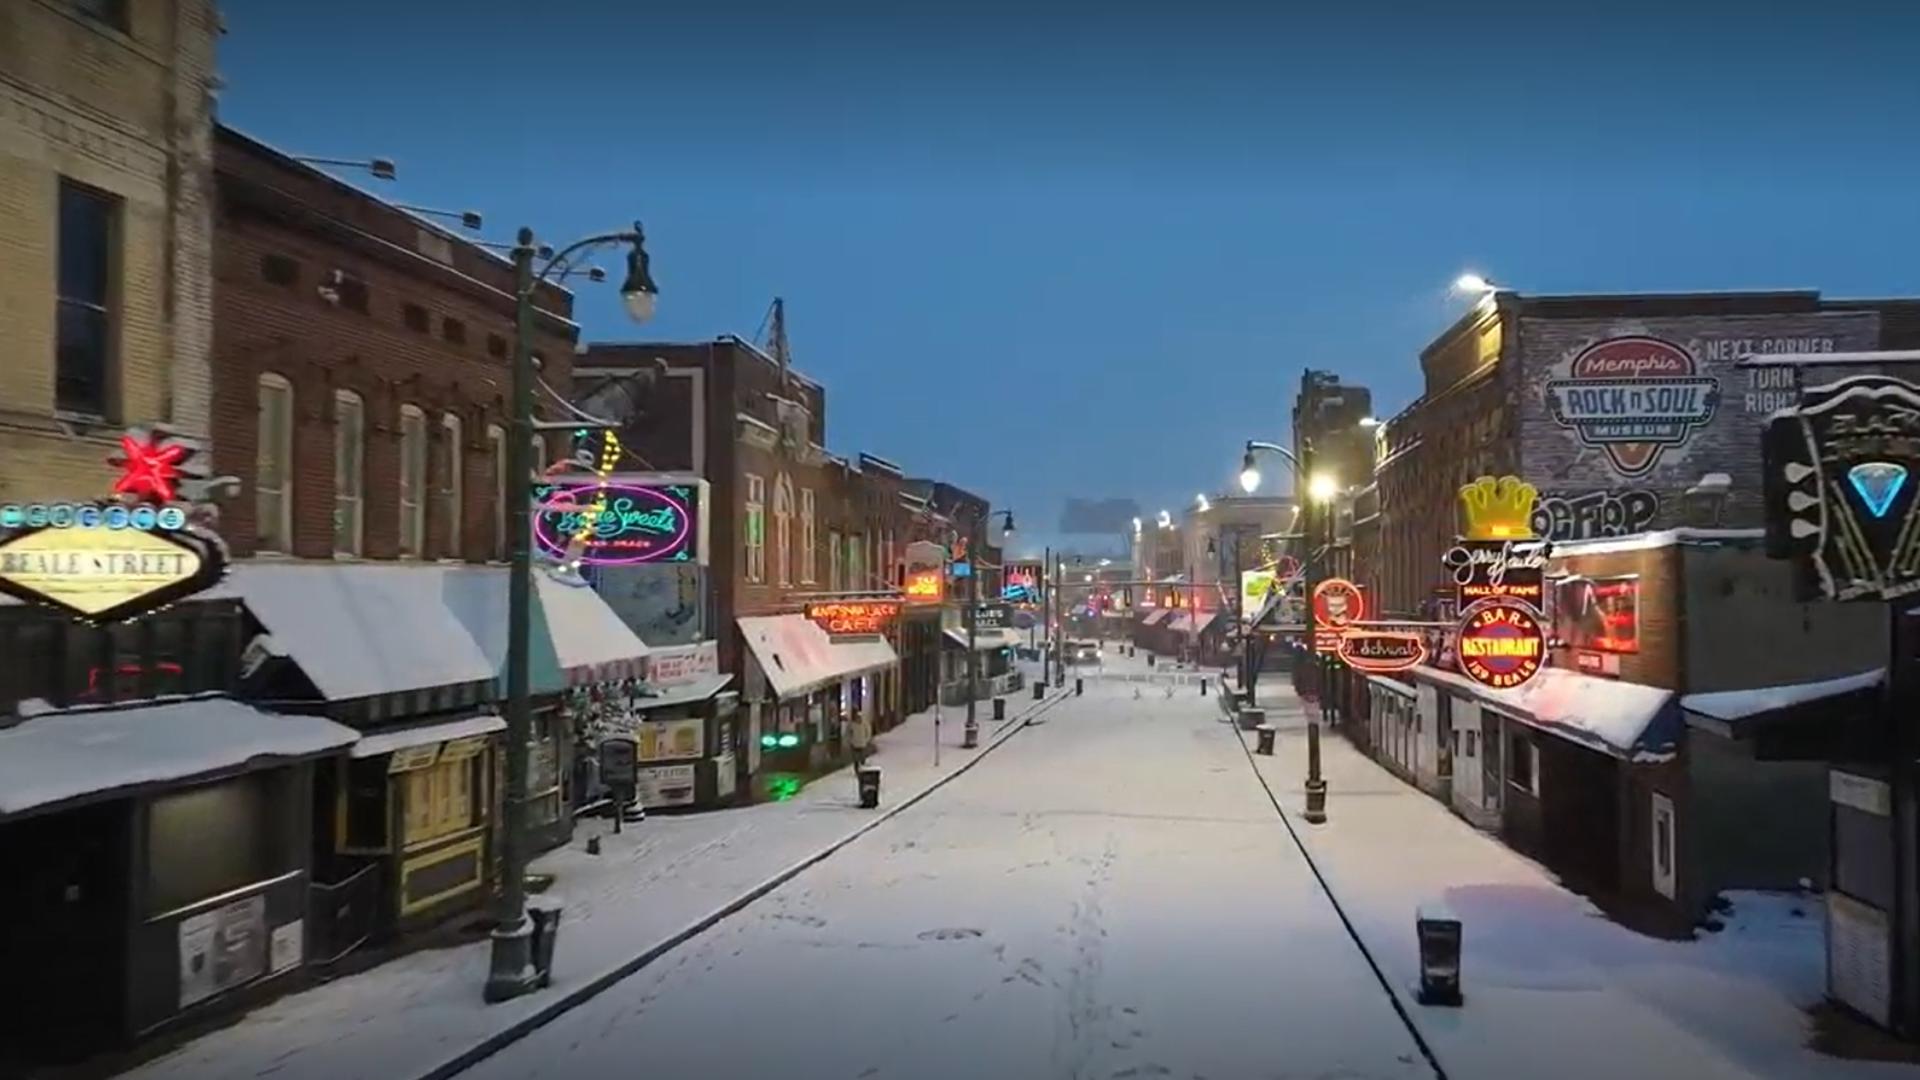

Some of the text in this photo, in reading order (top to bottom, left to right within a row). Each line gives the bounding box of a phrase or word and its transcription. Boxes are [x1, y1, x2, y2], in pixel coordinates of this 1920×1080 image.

[1706, 340, 1752, 361] NEXT
[1585, 352, 1682, 378] Memphis
[1749, 368, 1794, 389] TURN
[1567, 387, 1699, 415] ROCK n SOUL
[1594, 424, 1672, 436] MUSEUM
[1, 553, 80, 575] BEALE
[1464, 586, 1491, 595] HALL
[1510, 585, 1539, 595] FAME
[829, 619, 878, 631] CAFE
[1482, 607, 1521, 624] BAR
[1462, 637, 1540, 657] RESTAURANT
[1493, 660, 1537, 686] BEALE
